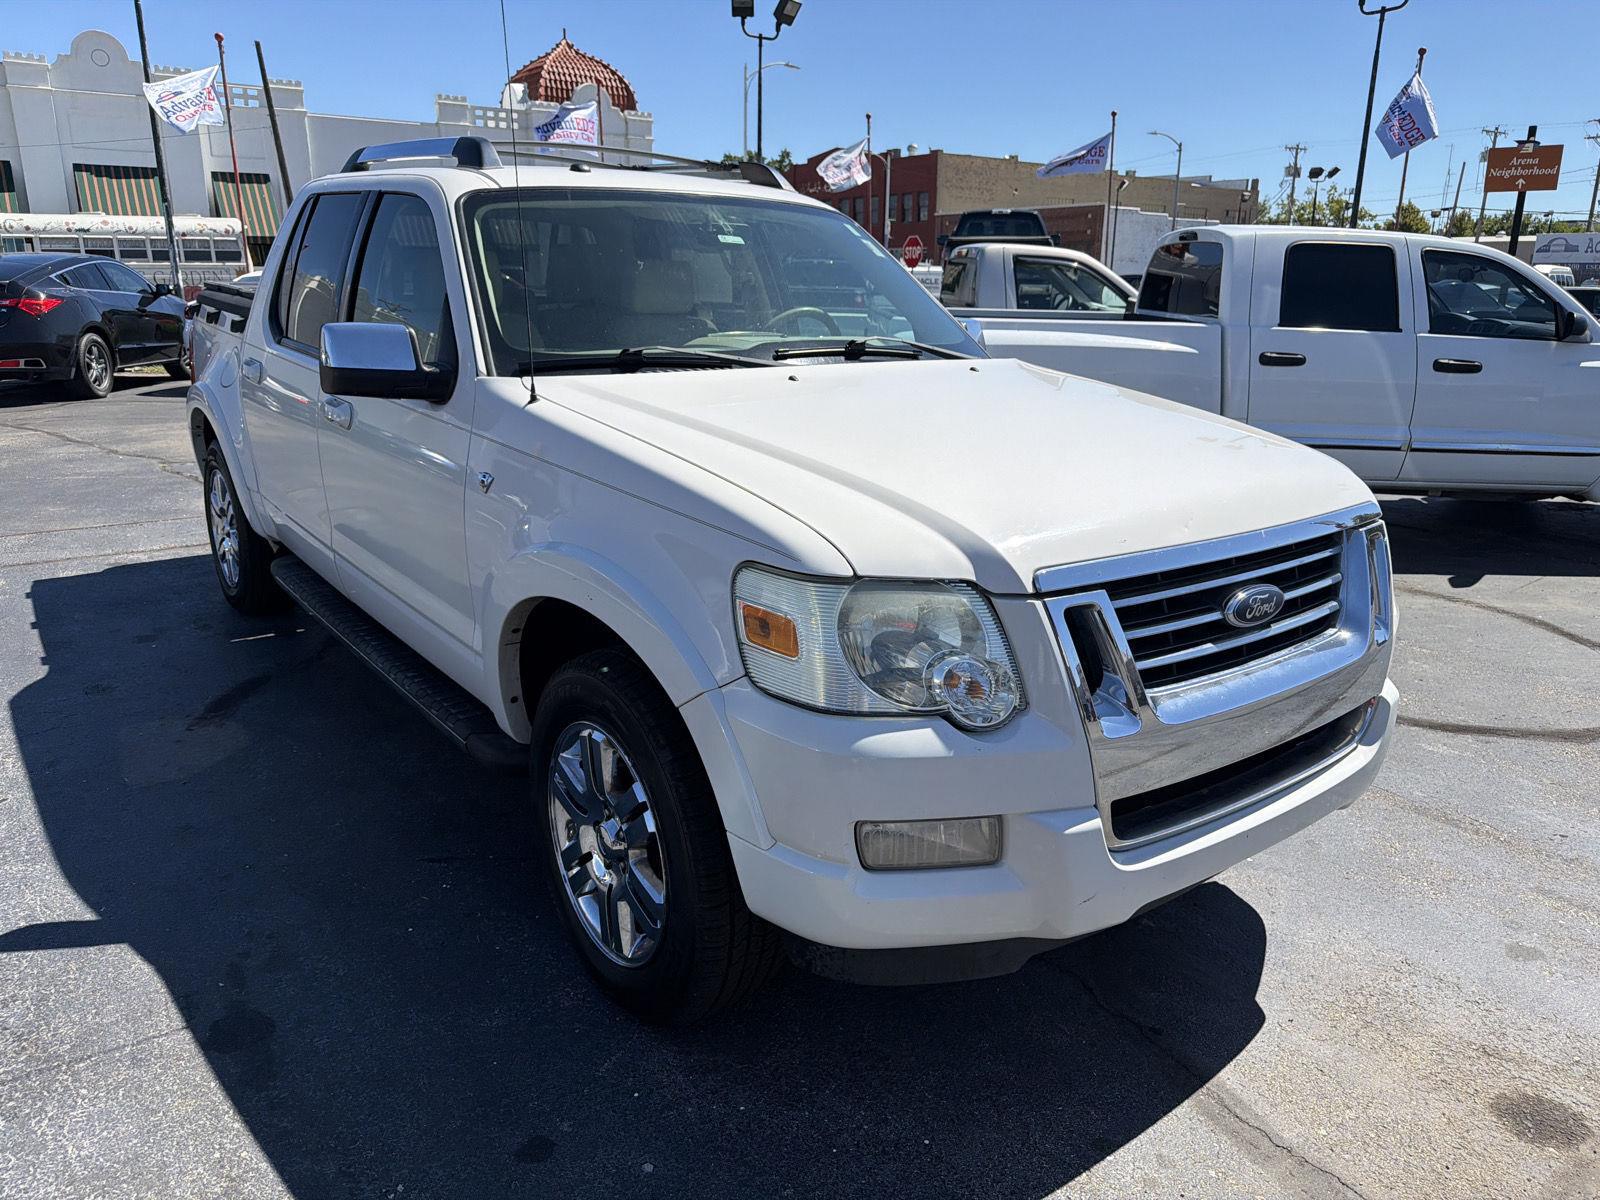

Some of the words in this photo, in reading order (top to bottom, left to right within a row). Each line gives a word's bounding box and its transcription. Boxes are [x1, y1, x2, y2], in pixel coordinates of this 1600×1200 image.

[1509, 157, 1540, 166] Arena
[1489, 165, 1558, 178] Neighborhood
[905, 246, 921, 259] STOP
[1246, 594, 1276, 619] Ford
